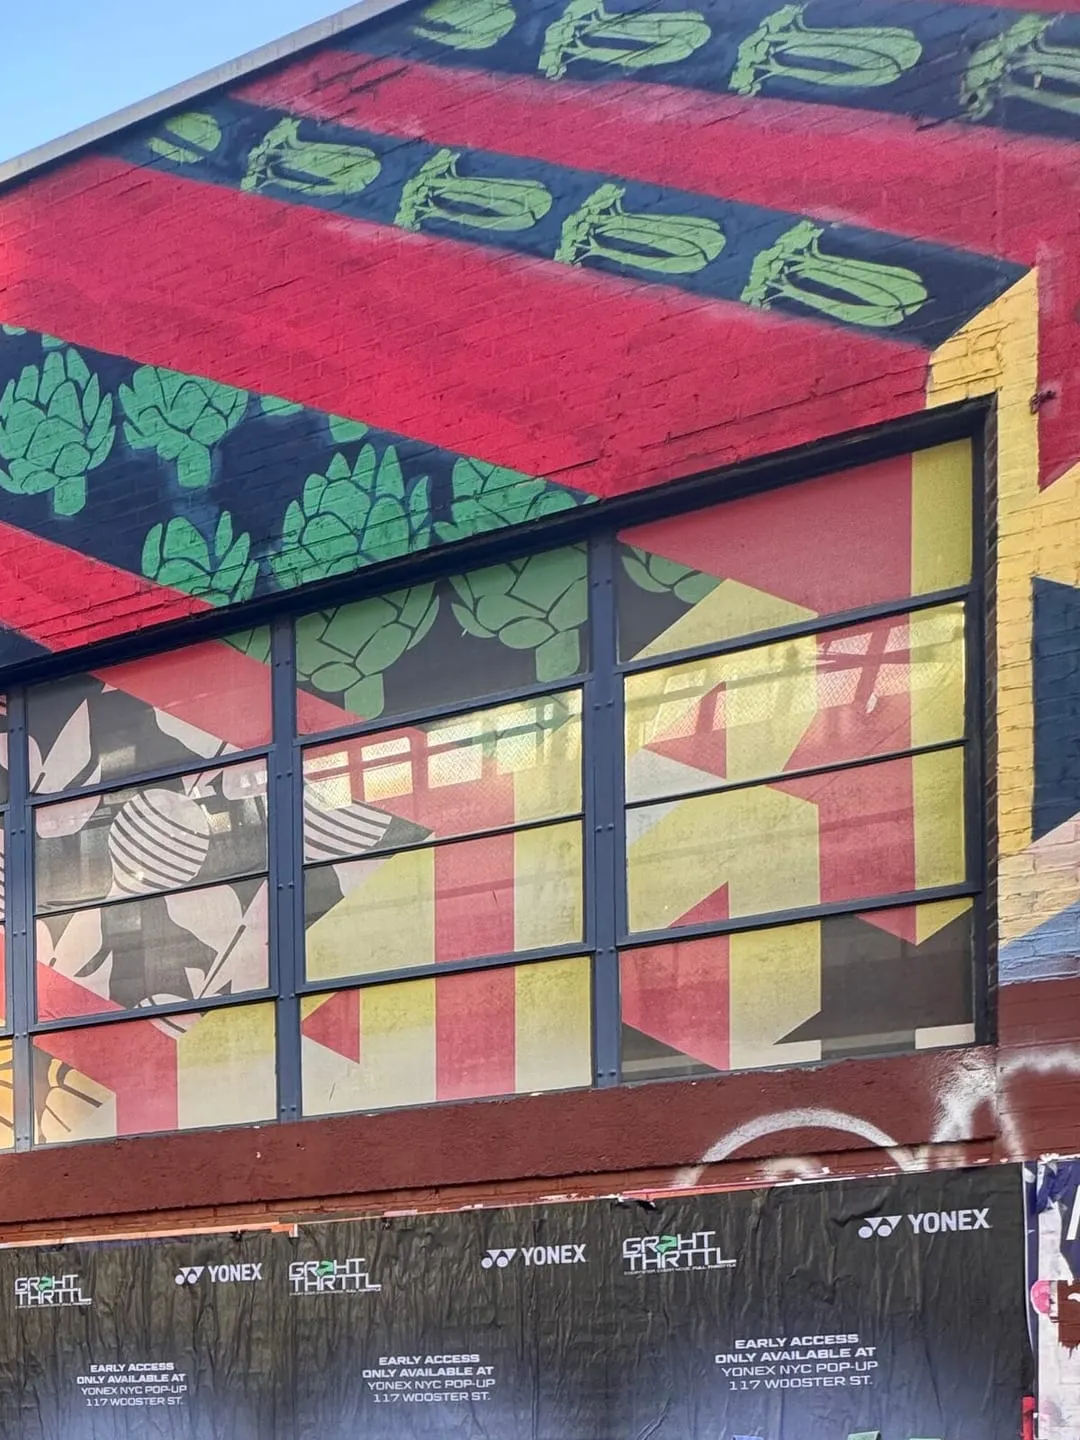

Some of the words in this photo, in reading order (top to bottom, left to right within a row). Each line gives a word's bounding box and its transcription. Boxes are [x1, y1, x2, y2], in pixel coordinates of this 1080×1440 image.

[907, 1208, 989, 1234] YONEX
[521, 1244, 586, 1265] YONEX
[623, 1247, 736, 1271] THRTTL
[208, 1263, 262, 1282] YONEX
[289, 1273, 382, 1291] THRTTL
[15, 1288, 92, 1305] THRTTL
[735, 1338, 787, 1349] EARLY
[790, 1334, 858, 1346] ACCESS
[379, 1356, 422, 1365] EARLY
[424, 1354, 479, 1364] ACCESS
[715, 1353, 757, 1363] ONLY
[760, 1348, 851, 1362] AVAILABLE
[855, 1347, 876, 1357] AT
[91, 1364, 125, 1372] EARLY
[128, 1363, 174, 1371] ACCESS
[362, 1369, 397, 1378] ONLY
[400, 1367, 473, 1377] AVAILABLE
[476, 1366, 494, 1375] AT
[721, 1366, 776, 1376] YONEX
[780, 1364, 812, 1374] NYC
[816, 1361, 878, 1373] POP-UP
[77, 1376, 105, 1384] ONLY
[108, 1374, 168, 1383] AVAILABLE
[171, 1374, 186, 1382] AT
[368, 1381, 411, 1390] YONEX
[415, 1380, 441, 1389] NYC
[445, 1379, 495, 1388] POP-UP
[729, 1380, 760, 1390] 117
[765, 1377, 845, 1389] WOOSTER
[850, 1375, 873, 1385] ST.
[81, 1387, 117, 1395] YONEX
[120, 1386, 142, 1394] NYC
[145, 1385, 187, 1394] POP-UP
[374, 1394, 400, 1402] 117
[402, 1392, 468, 1402] WOOSTER
[471, 1392, 491, 1400] ST.
[86, 1398, 108, 1406] 117
[110, 1397, 165, 1406] WOOSTER
[168, 1397, 183, 1405] ST.
